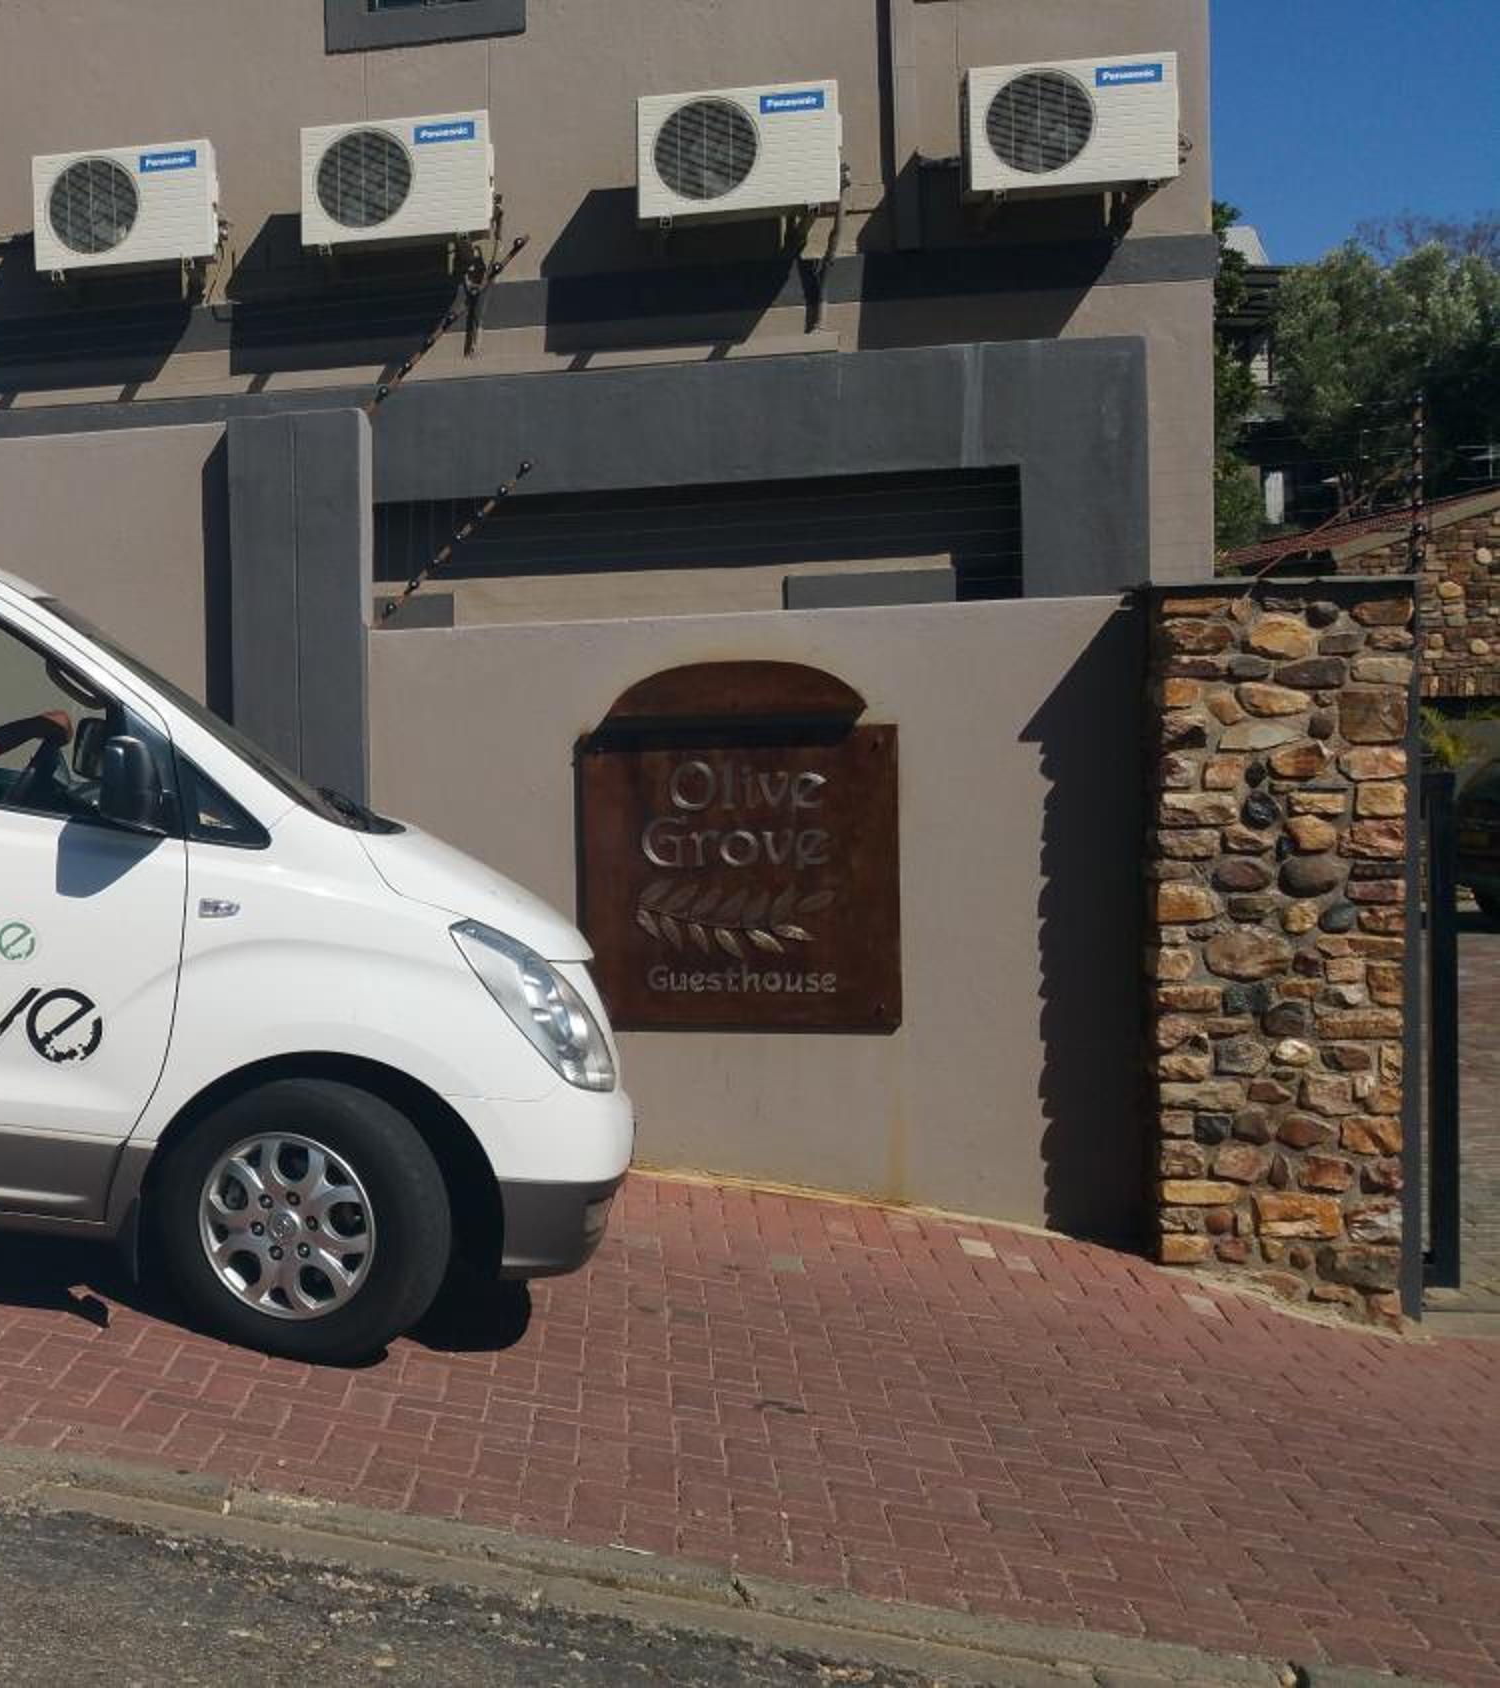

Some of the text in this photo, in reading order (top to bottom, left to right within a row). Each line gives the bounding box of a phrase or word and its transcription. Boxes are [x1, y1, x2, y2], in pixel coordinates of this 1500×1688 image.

[670, 760, 828, 811] Olive
[641, 816, 833, 869] Grove
[647, 965, 837, 993] Guesthouse
